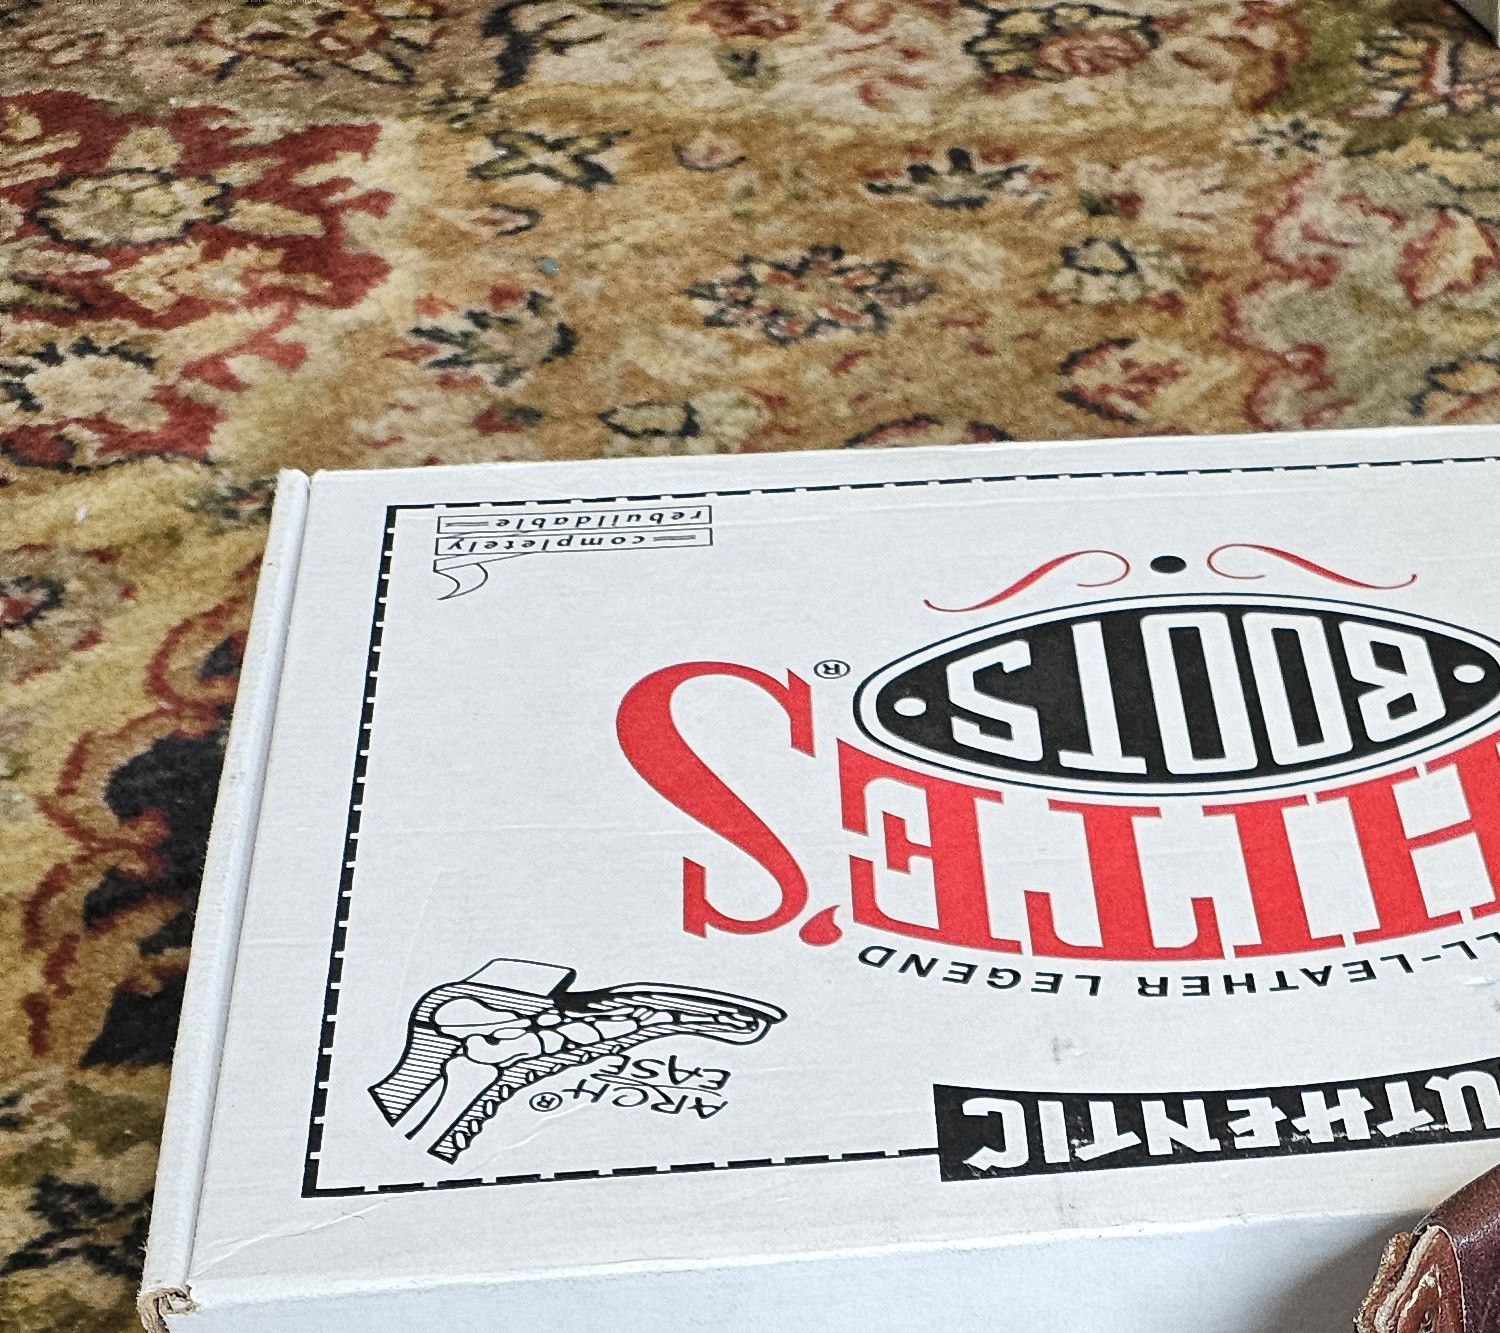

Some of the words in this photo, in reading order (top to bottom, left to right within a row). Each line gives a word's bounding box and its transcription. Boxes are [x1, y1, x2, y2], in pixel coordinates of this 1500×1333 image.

[496, 510, 701, 529] rebuildable
[447, 534, 645, 552] completely
[946, 611, 1444, 777] BOOTS
[858, 944, 1101, 997] LEGEND
[599, 1054, 731, 1090] EASE
[562, 1079, 728, 1119] ARCH
